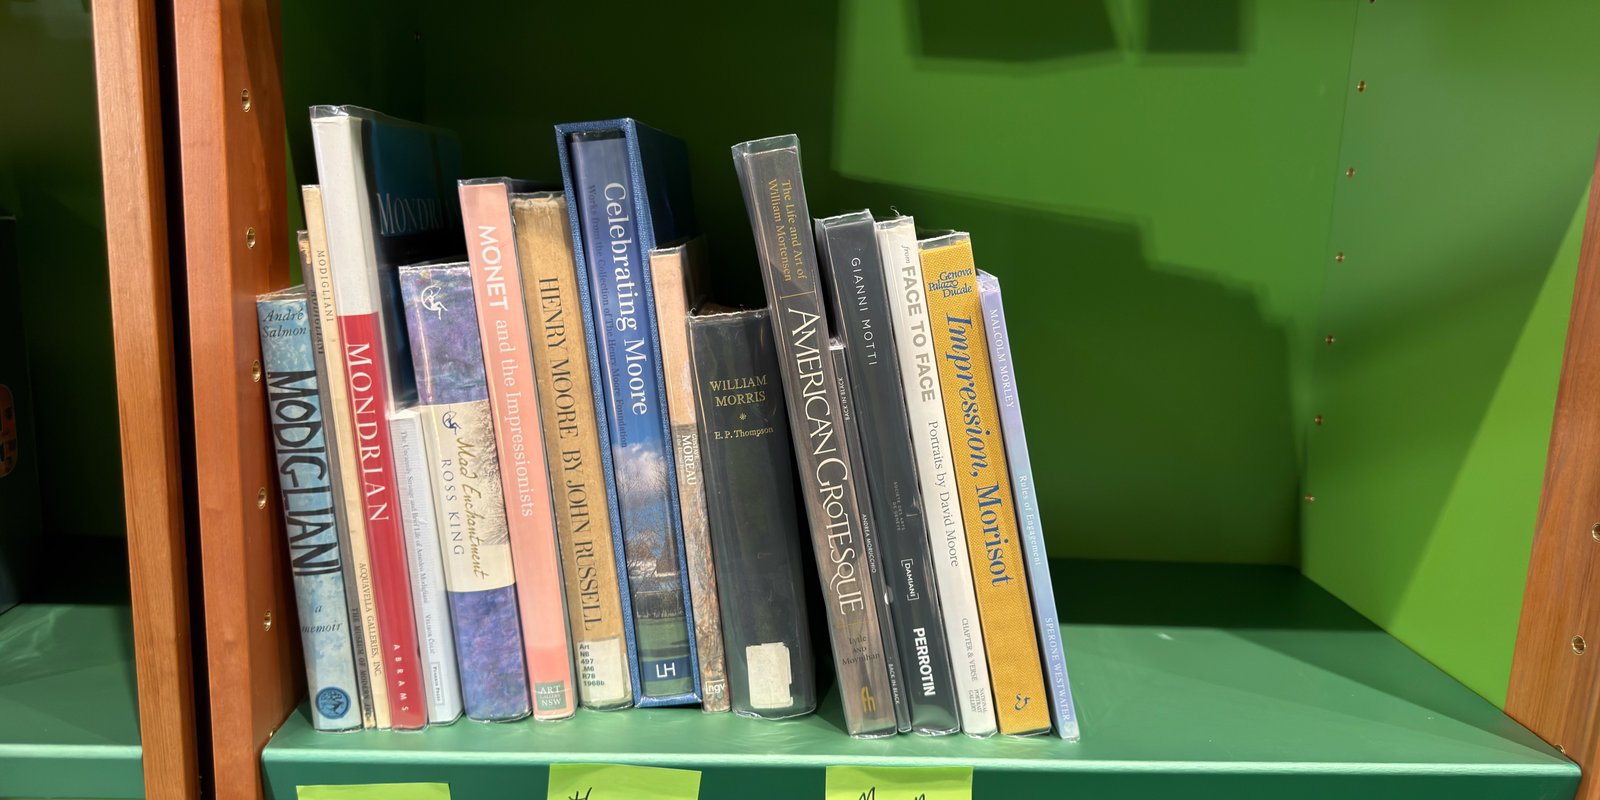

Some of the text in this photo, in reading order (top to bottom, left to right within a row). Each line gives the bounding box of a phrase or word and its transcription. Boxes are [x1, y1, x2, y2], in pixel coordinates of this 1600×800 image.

[588, 185, 598, 214] Works
[592, 217, 601, 239] from
[781, 179, 807, 280] The Life and Art of
[768, 179, 792, 282] William Mortensen
[317, 250, 334, 322] MODIGLIANI
[599, 259, 608, 305] Collection
[604, 182, 647, 415] Celebrating Moore
[940, 268, 972, 280] Genova
[942, 283, 972, 298] Ducale
[262, 326, 307, 338] Salmon
[263, 307, 304, 322] André
[603, 308, 610, 317] of
[606, 319, 615, 336] The
[851, 257, 878, 366] GIANNI MOTTI
[902, 245, 935, 402] from FACE TO FACE
[478, 225, 534, 517] MONET and the Impressionists
[607, 339, 618, 366] Henry
[611, 368, 620, 394] Moore
[710, 375, 767, 391] WILLIAM
[990, 308, 1014, 408] MALCOLM MORLEY
[715, 391, 766, 407] MORRIS
[838, 377, 846, 396] BLACK
[346, 342, 390, 521] MONDRIAN
[616, 399, 628, 447] Foundation
[714, 427, 773, 439] E. P. Thompson
[946, 313, 1014, 588] Impression, Morisot
[268, 370, 341, 577] MODIGLIANI
[539, 278, 602, 631] HENRY MOORE BY JOHN RUSSELL
[682, 435, 697, 485] MOREAU
[788, 308, 864, 615] AMERICAN GROTESQUE
[441, 459, 464, 555] ROSS KING
[456, 437, 489, 580] Mad Enchantment
[928, 420, 958, 567] Portraits by David Moore
[1019, 474, 1040, 565] Rules of Engagement
[866, 540, 876, 574] MORUCCHIO
[301, 620, 342, 634] memoir
[314, 605, 322, 613] a
[351, 608, 361, 622] THE
[359, 658, 366, 667] OF
[360, 562, 373, 612] ACQUAVELLA
[367, 615, 379, 658] GALLERIES,
[393, 644, 409, 711] ABRAMS
[913, 627, 936, 697] PERROTIN
[962, 618, 973, 651] CHAPTER
[969, 660, 978, 681] VERSE
[1045, 617, 1070, 720] SPERONE WESTWATER
[540, 685, 560, 694] ART
